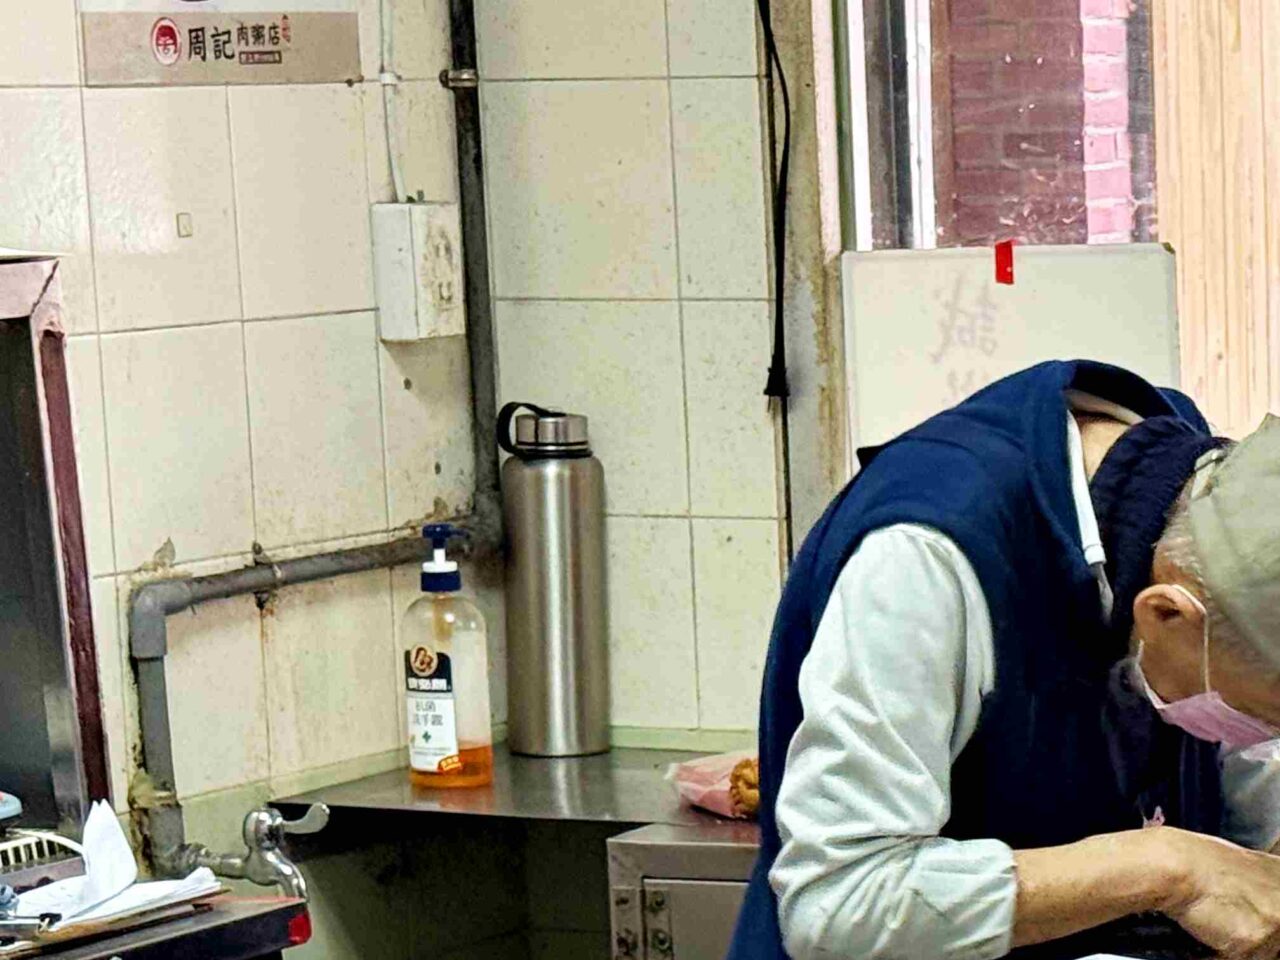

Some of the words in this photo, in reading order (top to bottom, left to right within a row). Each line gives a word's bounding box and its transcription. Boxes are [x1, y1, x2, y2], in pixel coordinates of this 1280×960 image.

[187, 22, 280, 62] 周記肉粥店
